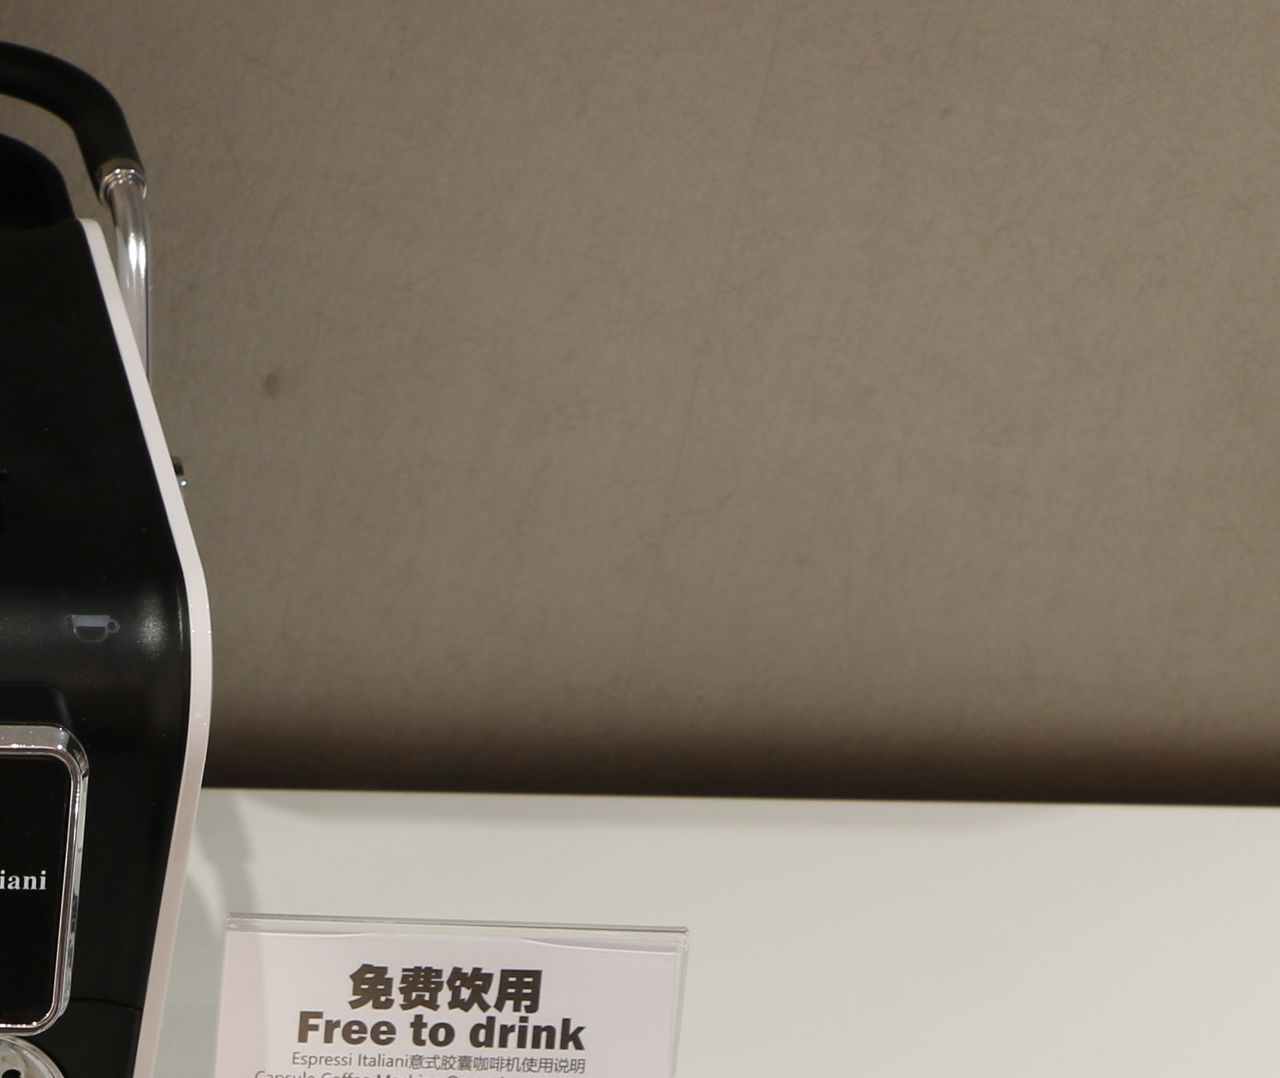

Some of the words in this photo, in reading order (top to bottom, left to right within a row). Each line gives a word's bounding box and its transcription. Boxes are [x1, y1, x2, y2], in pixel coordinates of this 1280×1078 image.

[348, 963, 543, 1014] 免费饮用
[297, 1010, 396, 1046] Free
[410, 1017, 456, 1048] to
[469, 1015, 587, 1050] drink
[292, 1052, 352, 1069] Espressi
